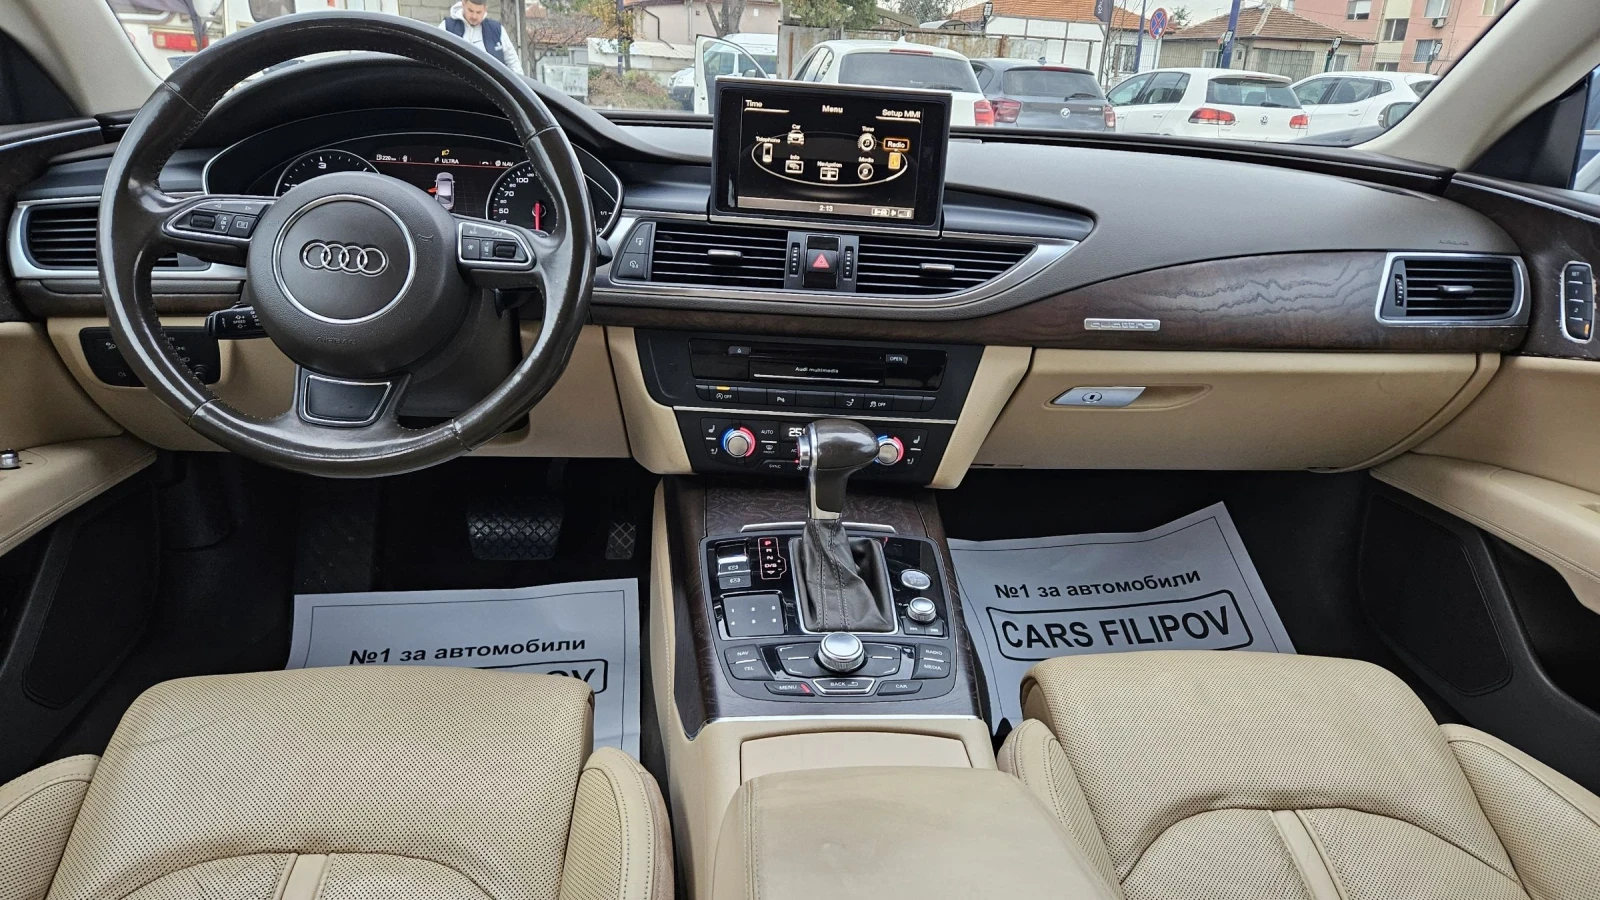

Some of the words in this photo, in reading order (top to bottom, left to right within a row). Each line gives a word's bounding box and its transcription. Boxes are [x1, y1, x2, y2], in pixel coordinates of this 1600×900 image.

[746, 100, 763, 108] Time
[822, 105, 843, 113] Menu
[882, 109, 903, 118] Setup
[904, 110, 921, 118] MMI
[1090, 321, 1155, 330] quattro
[994, 584, 1030, 599] №1
[1038, 586, 1061, 598] за
[1066, 570, 1202, 596] автомобили
[1001, 620, 1094, 648] CARS
[1099, 605, 1230, 646] FILIPOV
[349, 648, 392, 664] №1
[399, 648, 426, 662] за
[434, 638, 586, 660] автомобили
